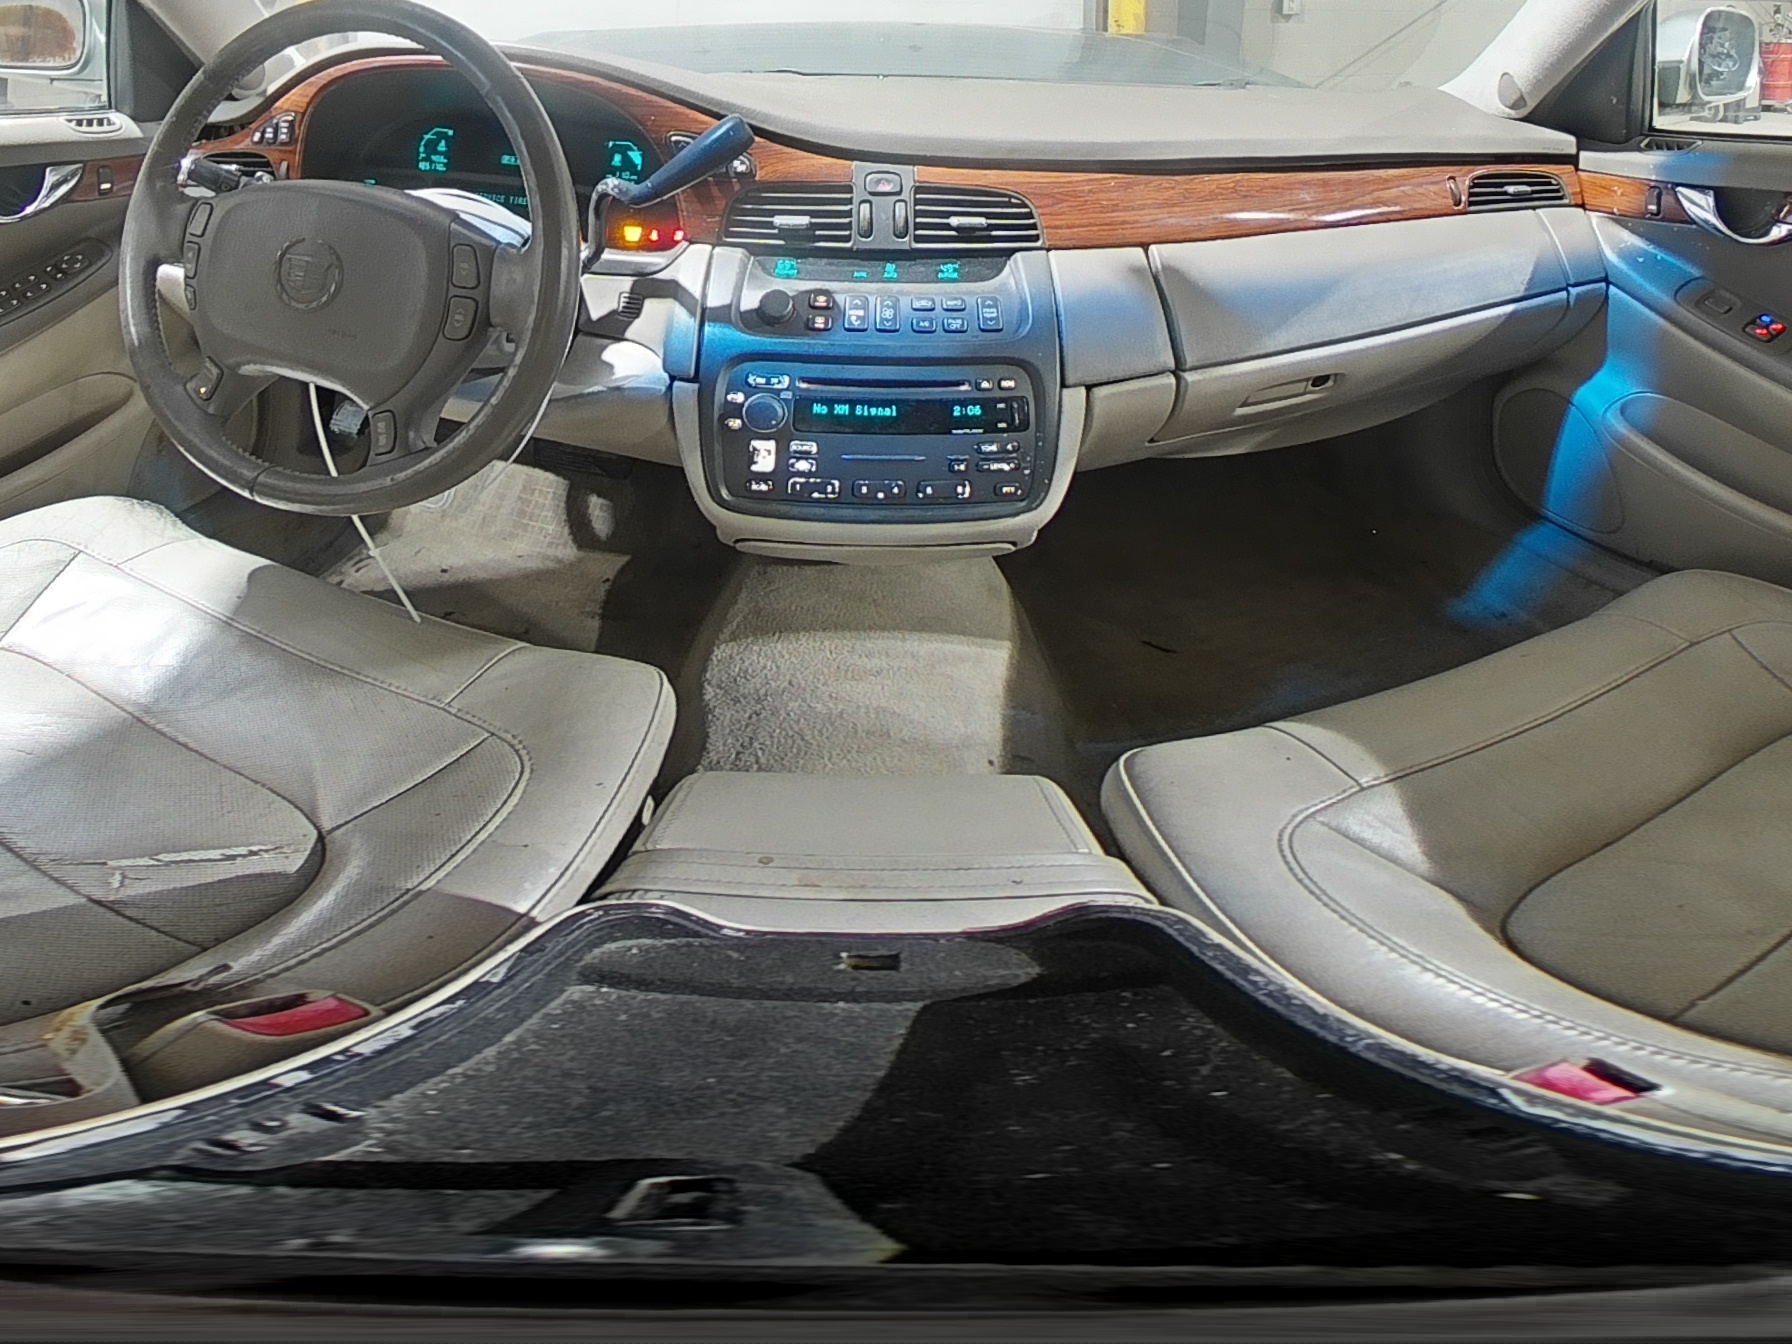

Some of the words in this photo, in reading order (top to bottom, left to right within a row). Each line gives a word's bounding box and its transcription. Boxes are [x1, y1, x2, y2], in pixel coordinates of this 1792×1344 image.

[812, 403, 829, 415] No
[833, 403, 850, 416] XM
[855, 404, 897, 417] Signal
